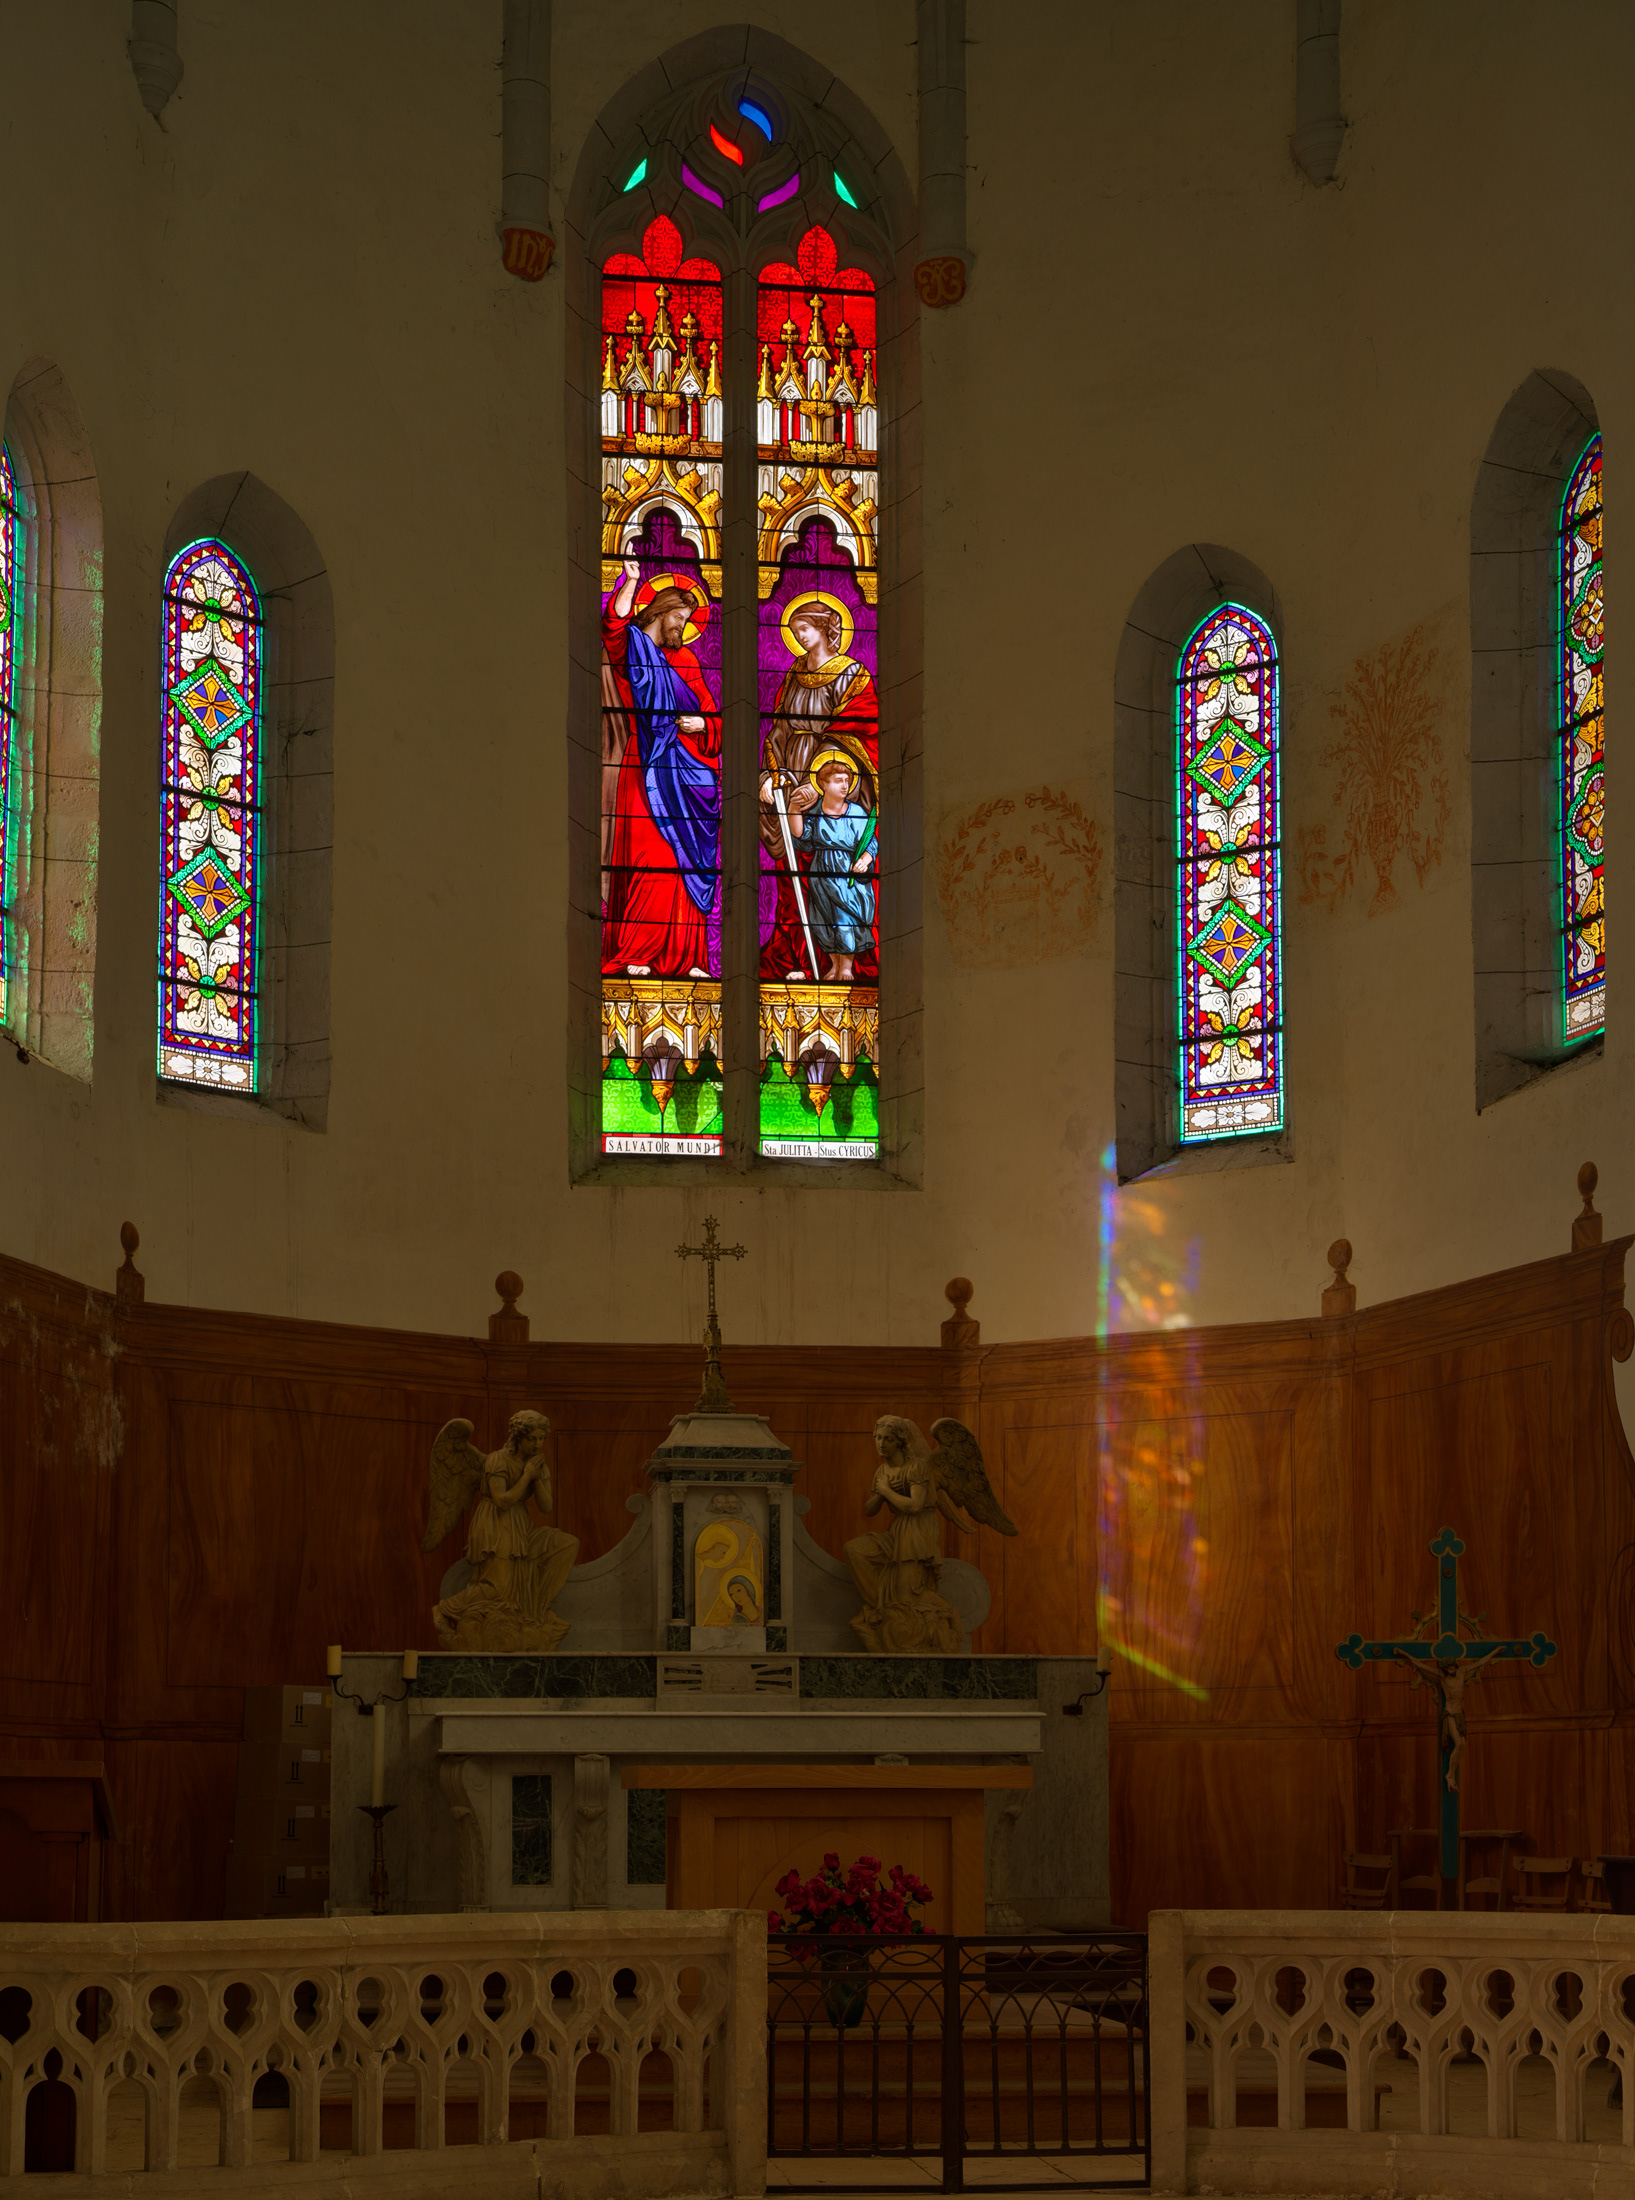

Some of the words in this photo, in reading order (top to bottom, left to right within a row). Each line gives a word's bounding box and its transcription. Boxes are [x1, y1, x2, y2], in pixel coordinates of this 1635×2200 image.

[608, 1140, 670, 1153] SALVATOR
[677, 1142, 717, 1154] MUNDI
[779, 1144, 812, 1157] JULITTA
[838, 1146, 875, 1158] CYRICUS
